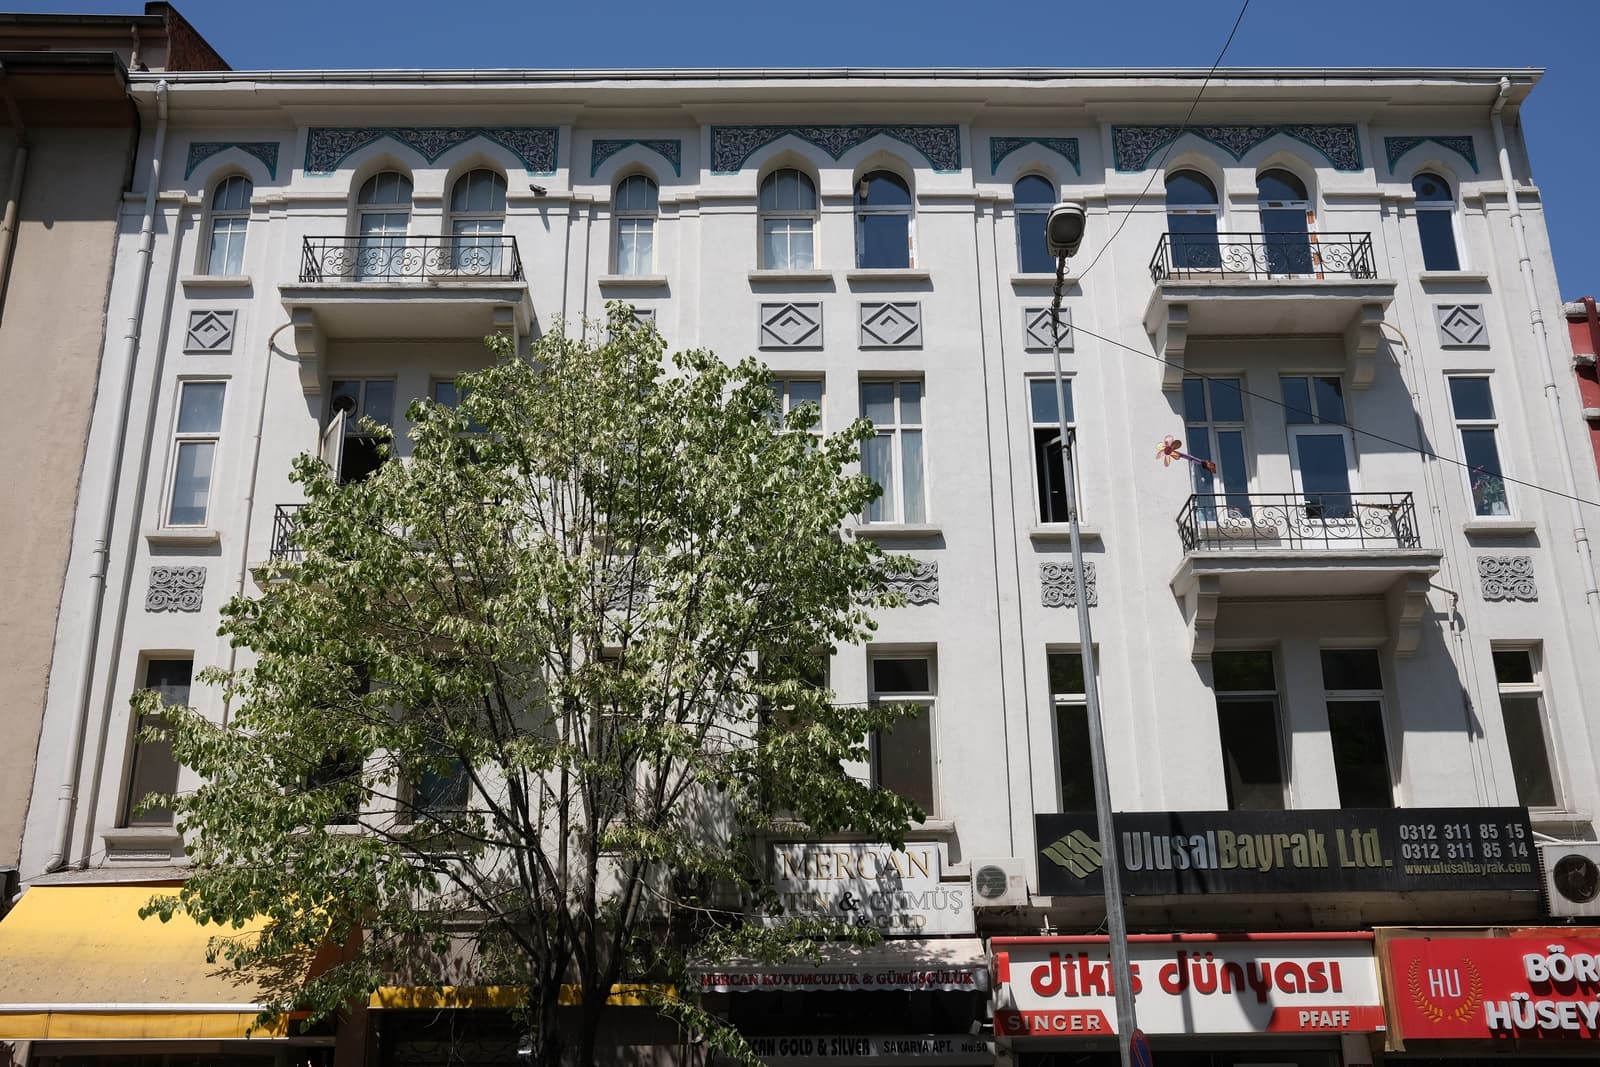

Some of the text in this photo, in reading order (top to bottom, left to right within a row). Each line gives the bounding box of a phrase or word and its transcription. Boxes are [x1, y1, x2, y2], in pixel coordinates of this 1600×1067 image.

[1400, 823, 1525, 840] 0312 311 85 15
[1122, 828, 1393, 872] UlusalBayrak Ltd.
[1402, 842, 1528, 859] 0312 311 85 14
[780, 850, 930, 880] MERCAN
[1404, 862, 1532, 876] www.ulusalbayrak.com
[782, 886, 963, 914] TIN & GÜMÜŞ
[875, 914, 927, 929] GOLD
[1523, 944, 1600, 982] BÖR
[701, 973, 759, 986] MERCAN
[762, 973, 860, 986] KUYUMCULUK
[863, 973, 873, 985] &
[1158, 951, 1342, 1004] dünyası
[1428, 968, 1461, 997] HU
[1299, 1010, 1350, 1027] PFAFF
[1484, 992, 1600, 1030] HÜSEY
[1008, 1015, 1101, 1031] SINGER
[780, 1038, 813, 1056] GOLD
[817, 1038, 827, 1056] &
[883, 1040, 930, 1053] SAKARYA
[932, 1040, 954, 1053] APT.
